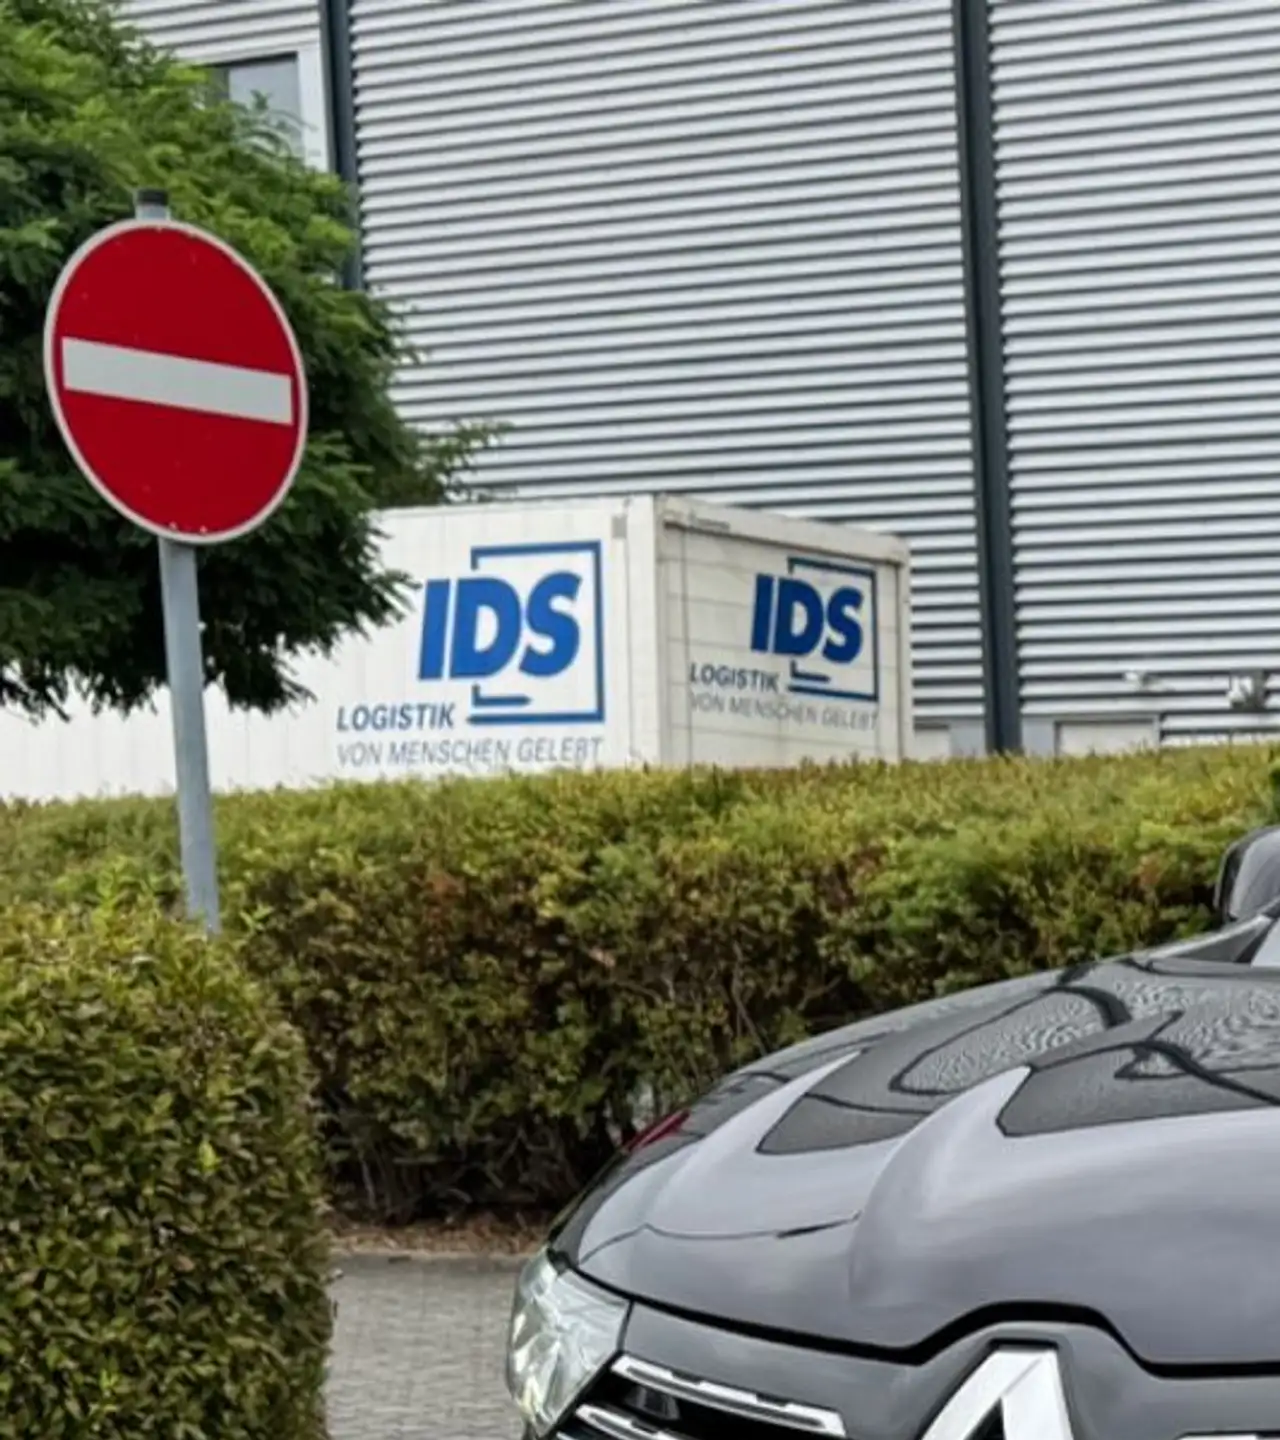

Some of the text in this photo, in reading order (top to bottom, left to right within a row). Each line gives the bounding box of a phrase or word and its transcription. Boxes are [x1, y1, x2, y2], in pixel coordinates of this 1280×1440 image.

[417, 570, 582, 681] IDS
[751, 573, 864, 664] IDS
[690, 663, 780, 693] LOGISTIK
[336, 703, 456, 731] LOGISTIK
[690, 693, 878, 731] VON MENSCHEN GELEBT
[337, 737, 603, 767] VON MENSCHEN GELEBT
